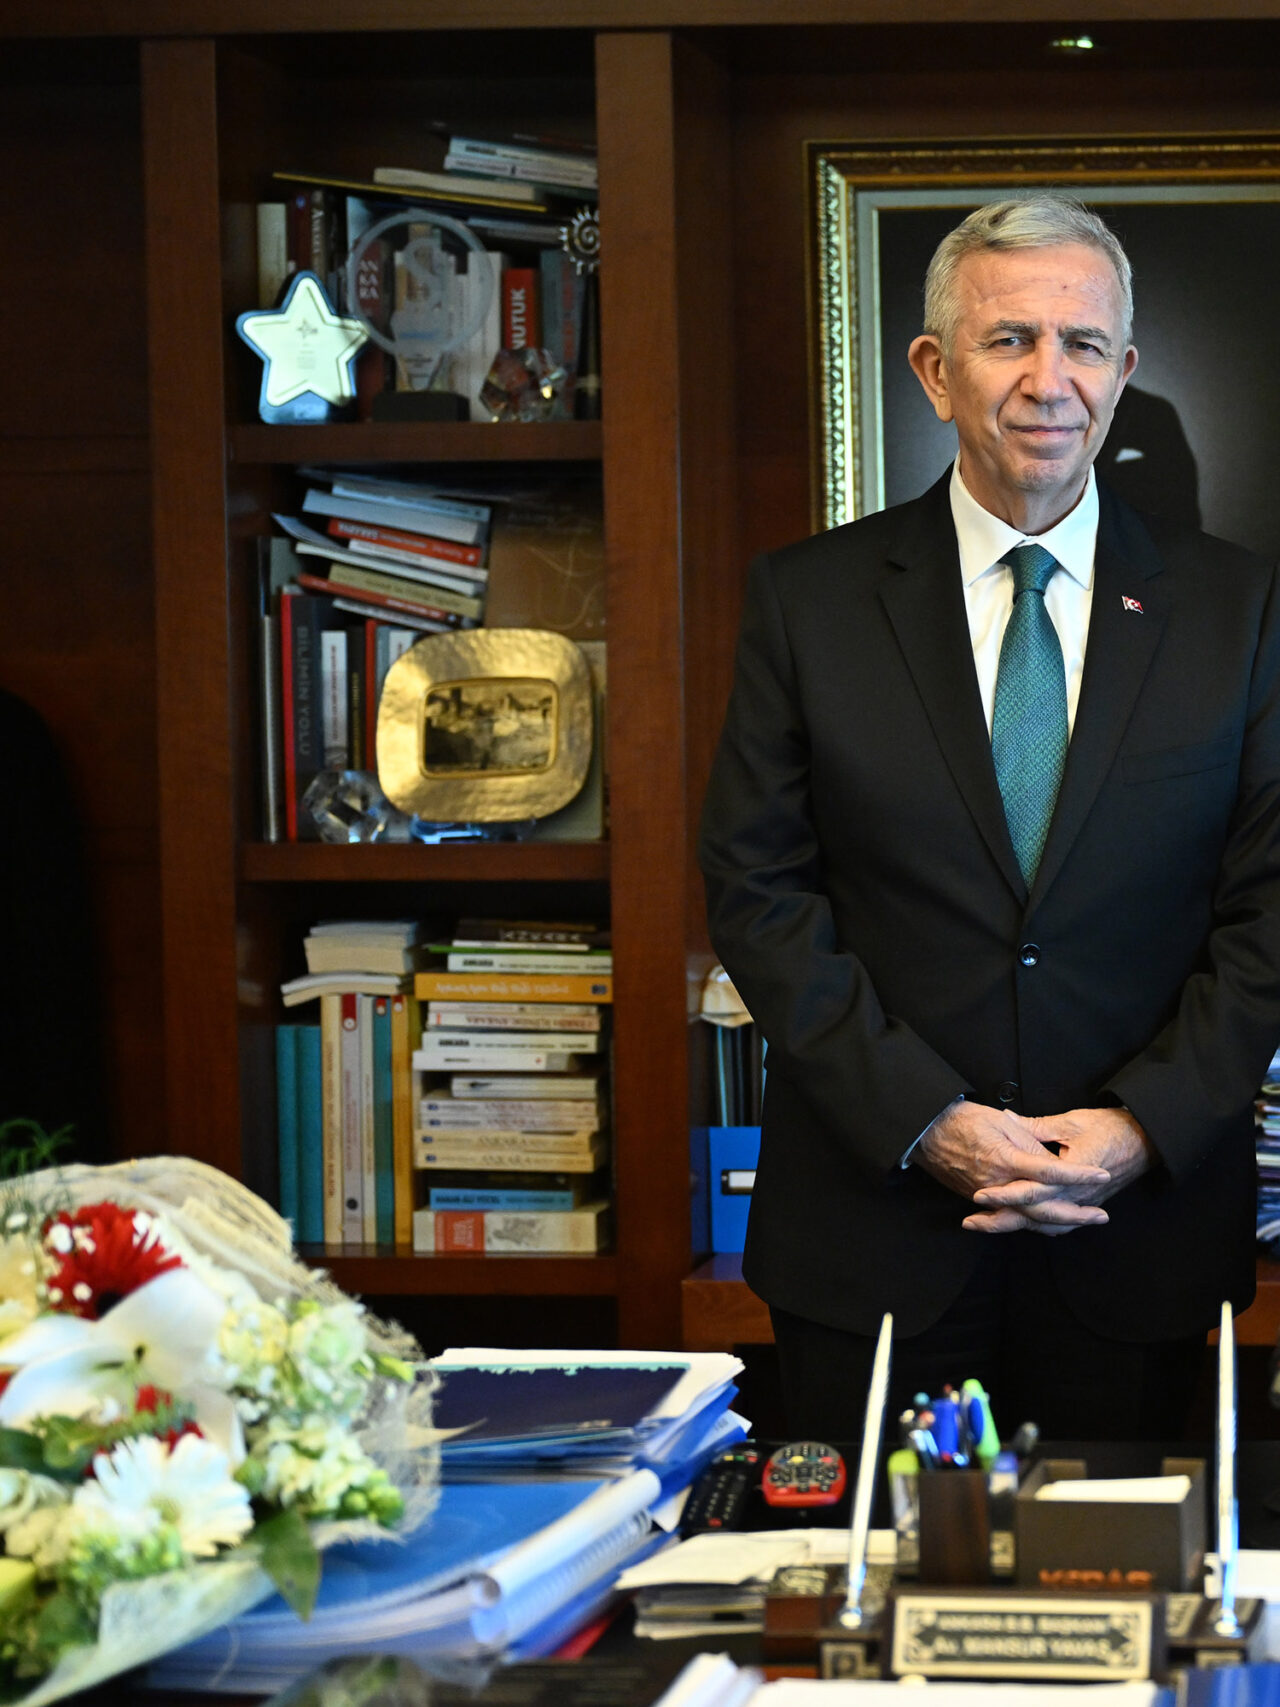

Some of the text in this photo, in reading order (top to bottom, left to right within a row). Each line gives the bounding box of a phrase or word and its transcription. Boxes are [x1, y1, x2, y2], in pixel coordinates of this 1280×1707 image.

[510, 288, 526, 349] NUTUK
[297, 707, 310, 755] YOLU
[962, 1637, 1047, 1658] MANSUR
